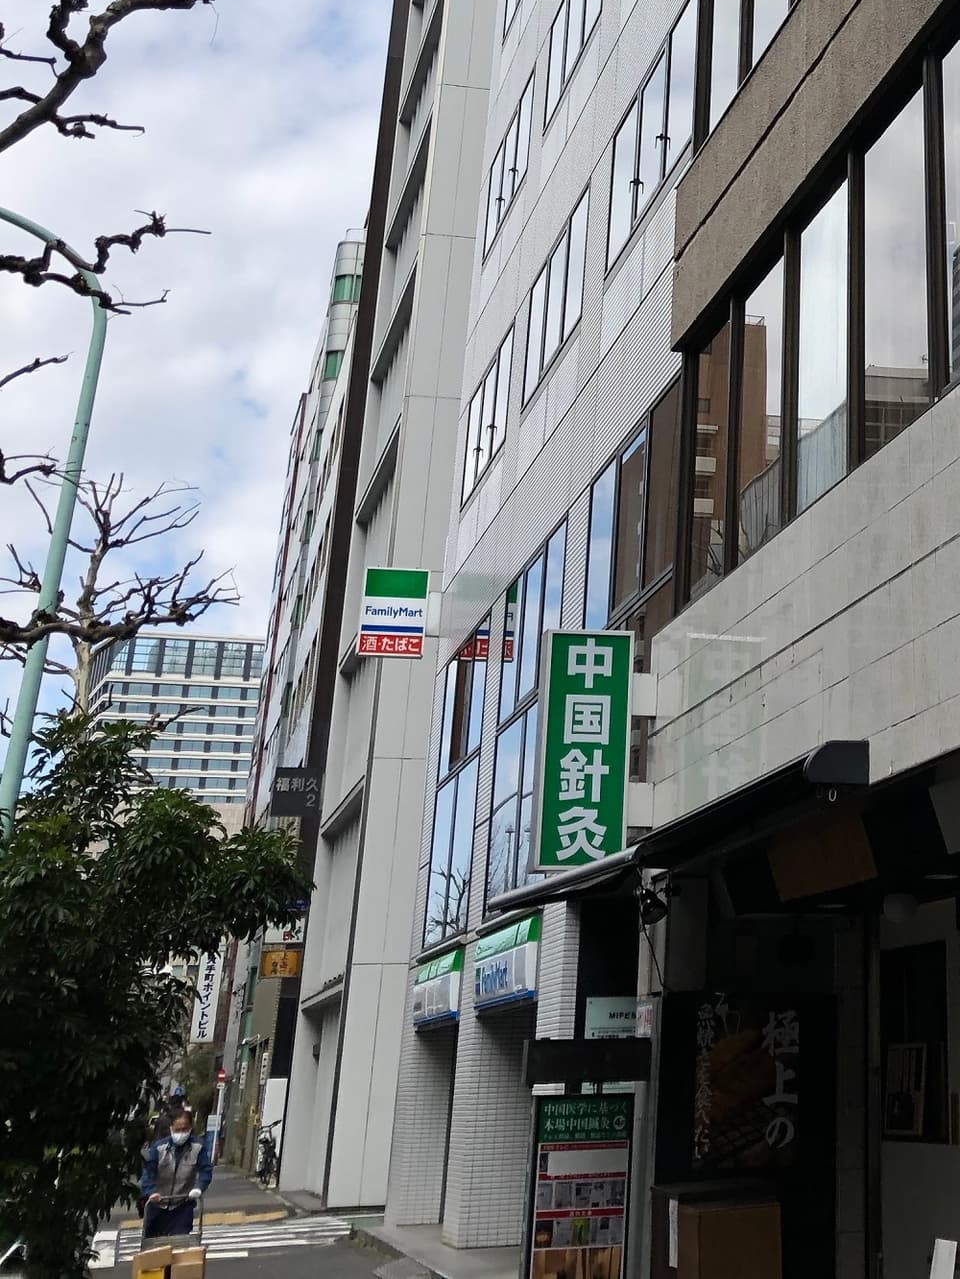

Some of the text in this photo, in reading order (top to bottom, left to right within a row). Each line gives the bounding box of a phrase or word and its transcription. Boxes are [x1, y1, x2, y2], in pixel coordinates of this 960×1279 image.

[365, 605, 423, 619] FamilyMart
[275, 777, 319, 792] 福利久
[556, 638, 613, 861] 中国針灸
[761, 1009, 800, 1149] 極上の
